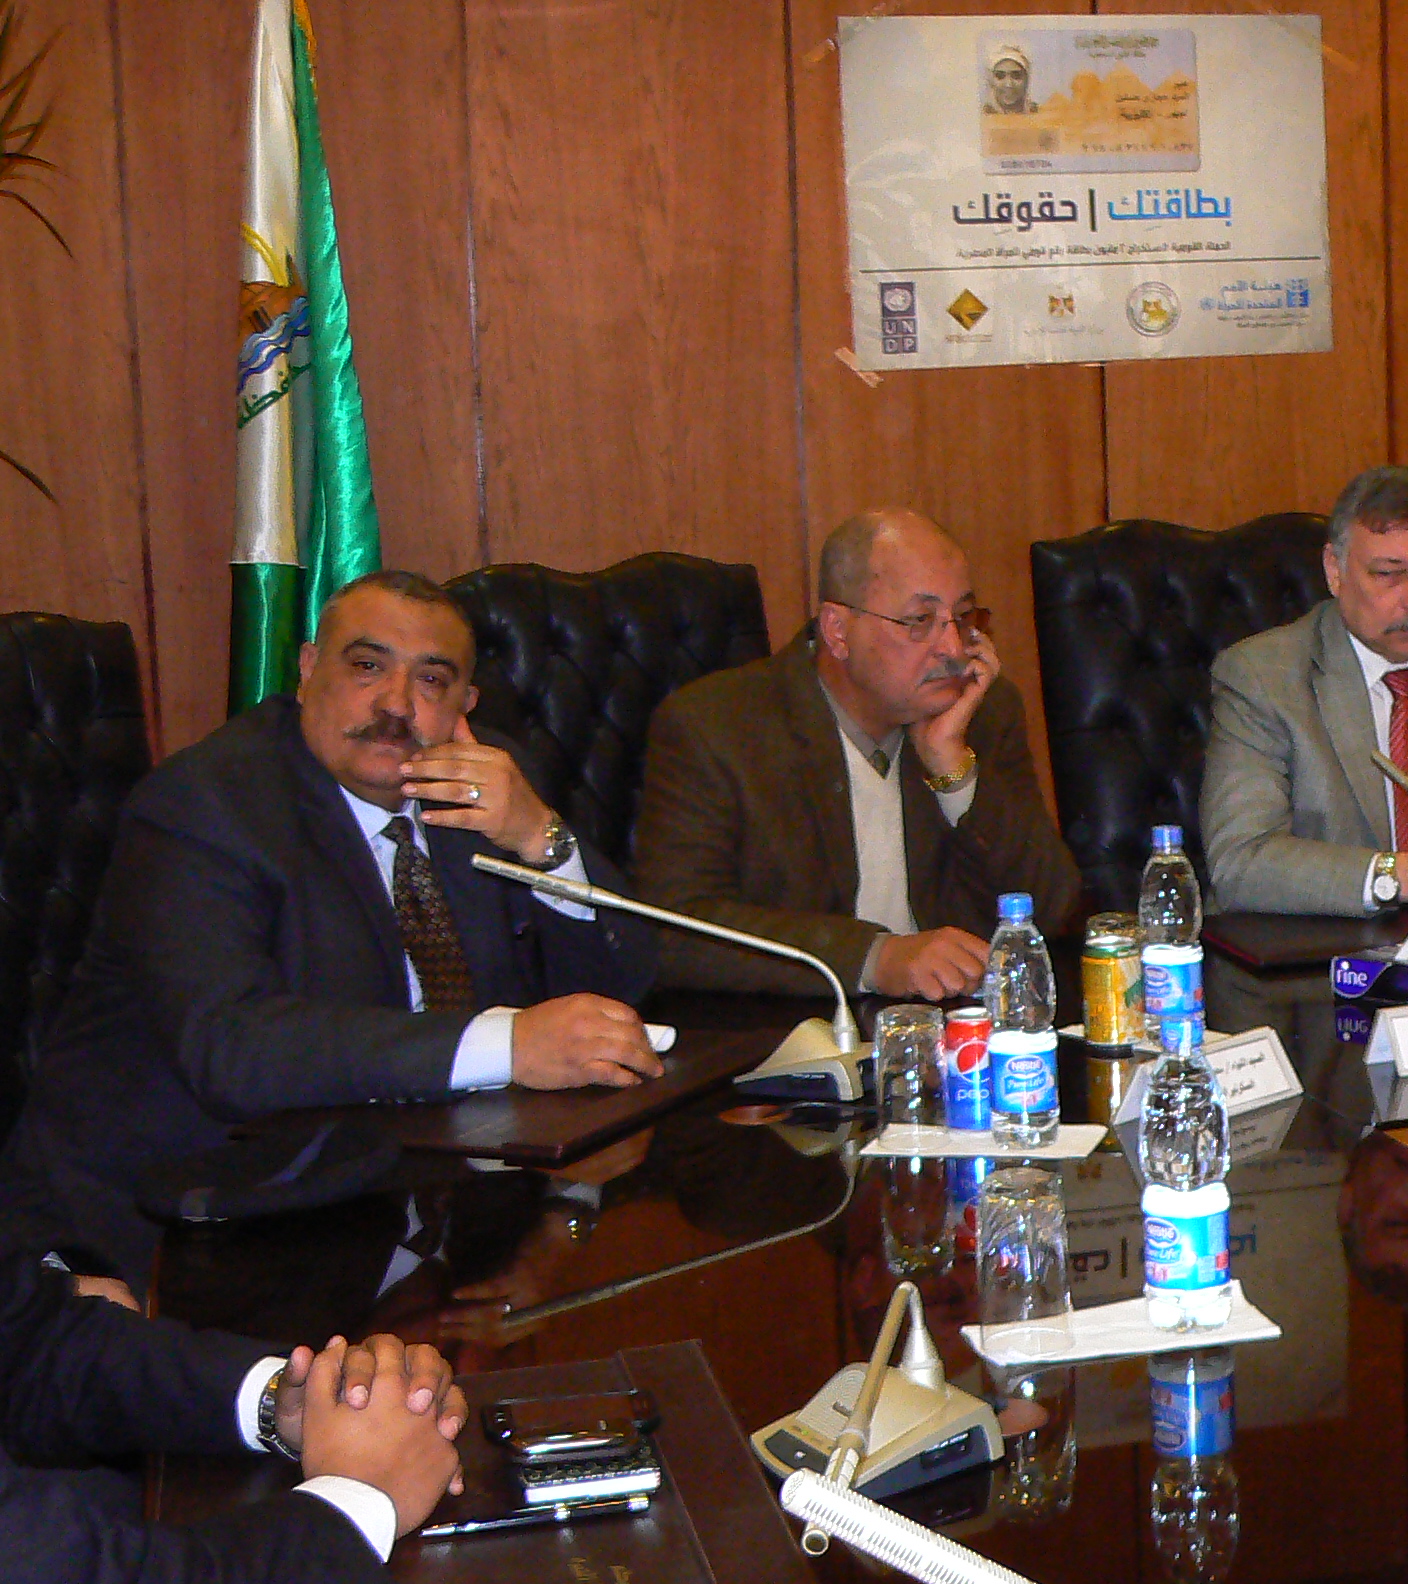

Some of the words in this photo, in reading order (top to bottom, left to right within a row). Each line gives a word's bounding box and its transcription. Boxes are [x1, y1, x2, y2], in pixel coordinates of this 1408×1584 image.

[952, 191, 1078, 232] حقوقك
[1107, 188, 1232, 227] بطاقتك
[955, 1089, 990, 1101] pep
